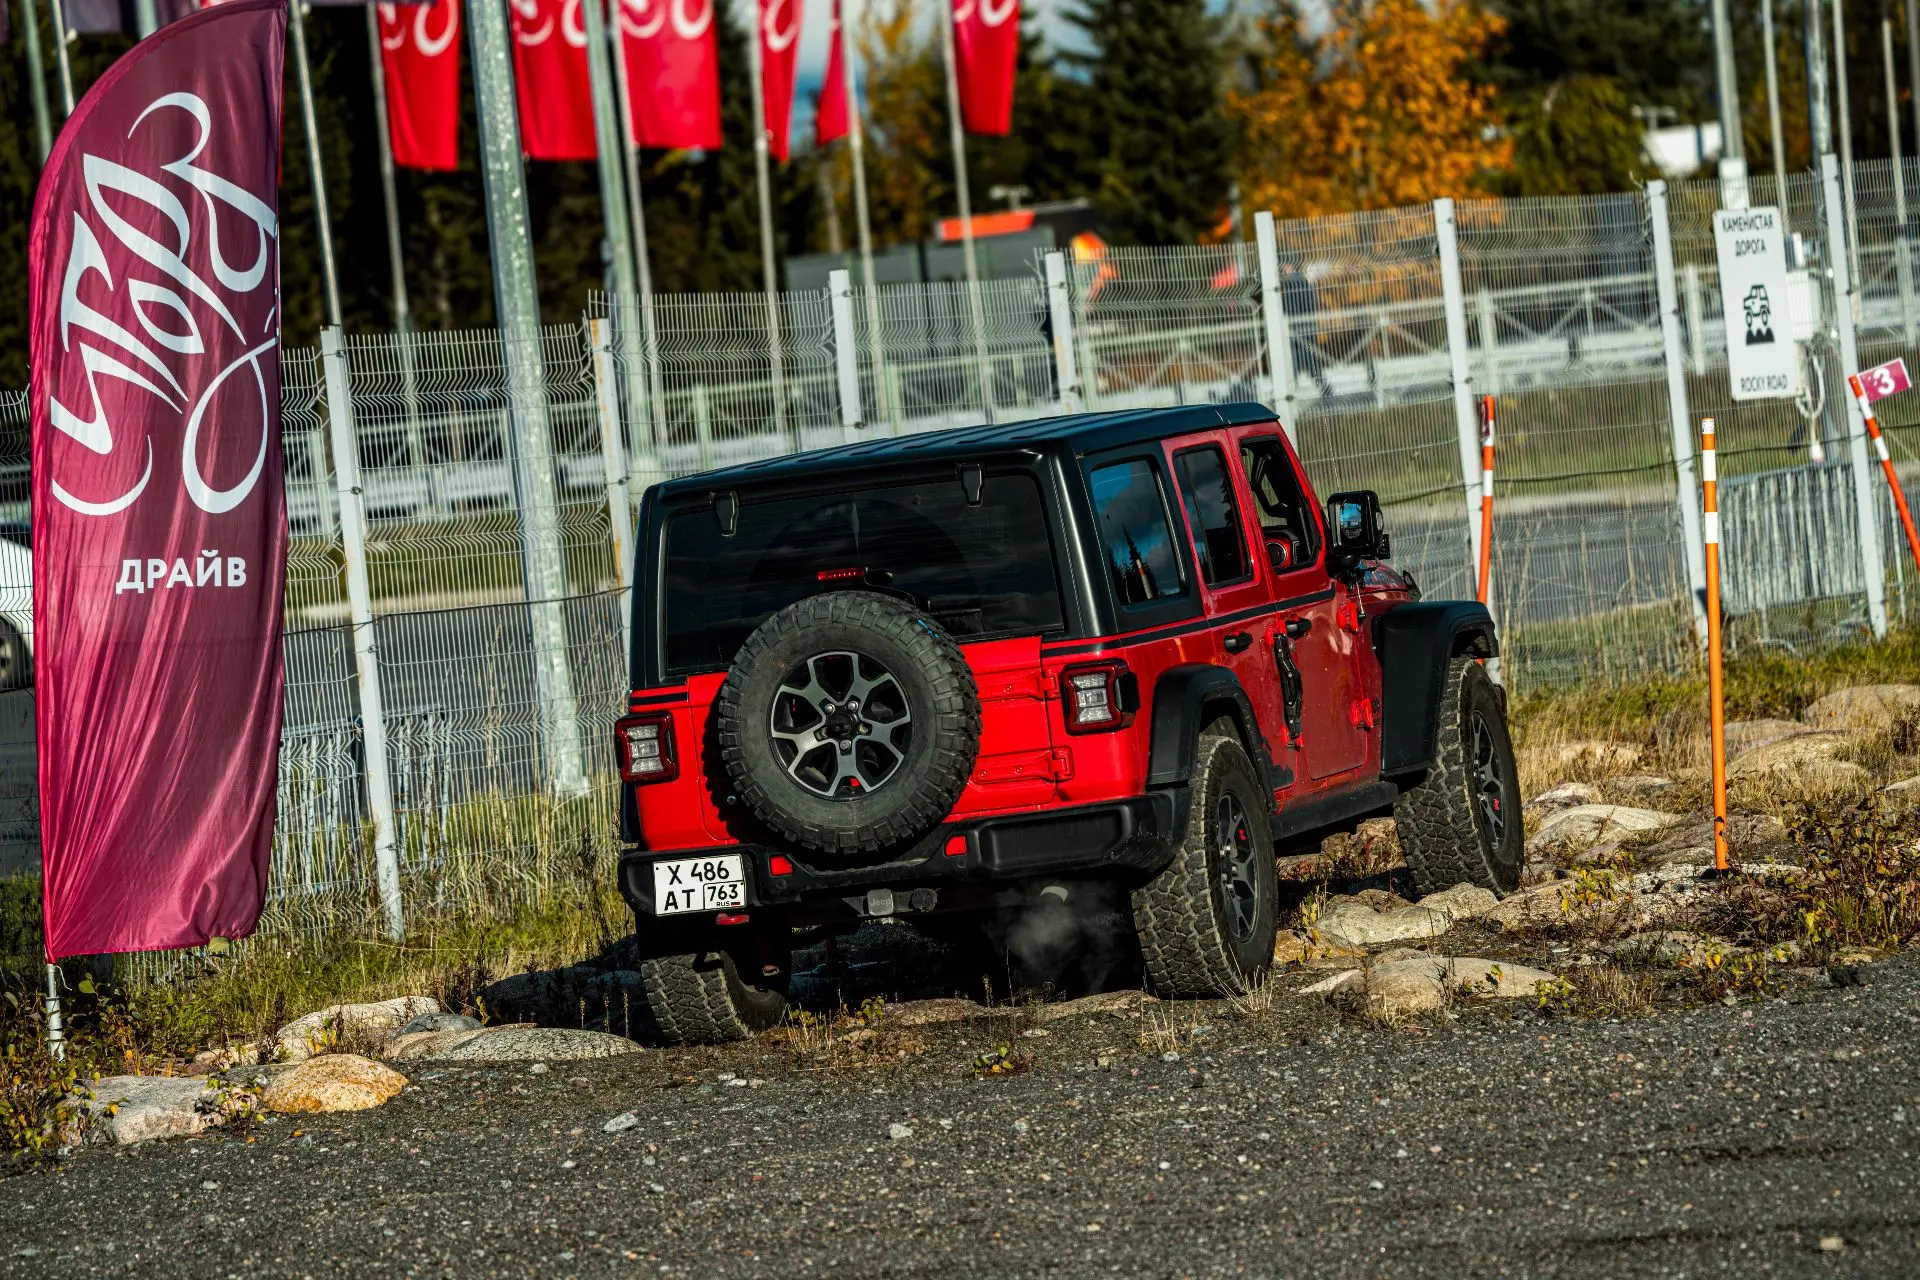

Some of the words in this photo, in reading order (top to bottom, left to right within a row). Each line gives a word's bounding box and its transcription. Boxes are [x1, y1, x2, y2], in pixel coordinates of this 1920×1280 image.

[1721, 213, 1775, 234] КАМЕНИСТАЯ
[1735, 238, 1767, 257] ДОРОГА
[1740, 376, 1766, 392] ROCKY
[1766, 374, 1788, 391] ROAD
[1873, 367, 1896, 395] 3
[115, 549, 248, 595] ДРАЙВ
[690, 860, 730, 882] 486
[707, 884, 738, 902] 763
